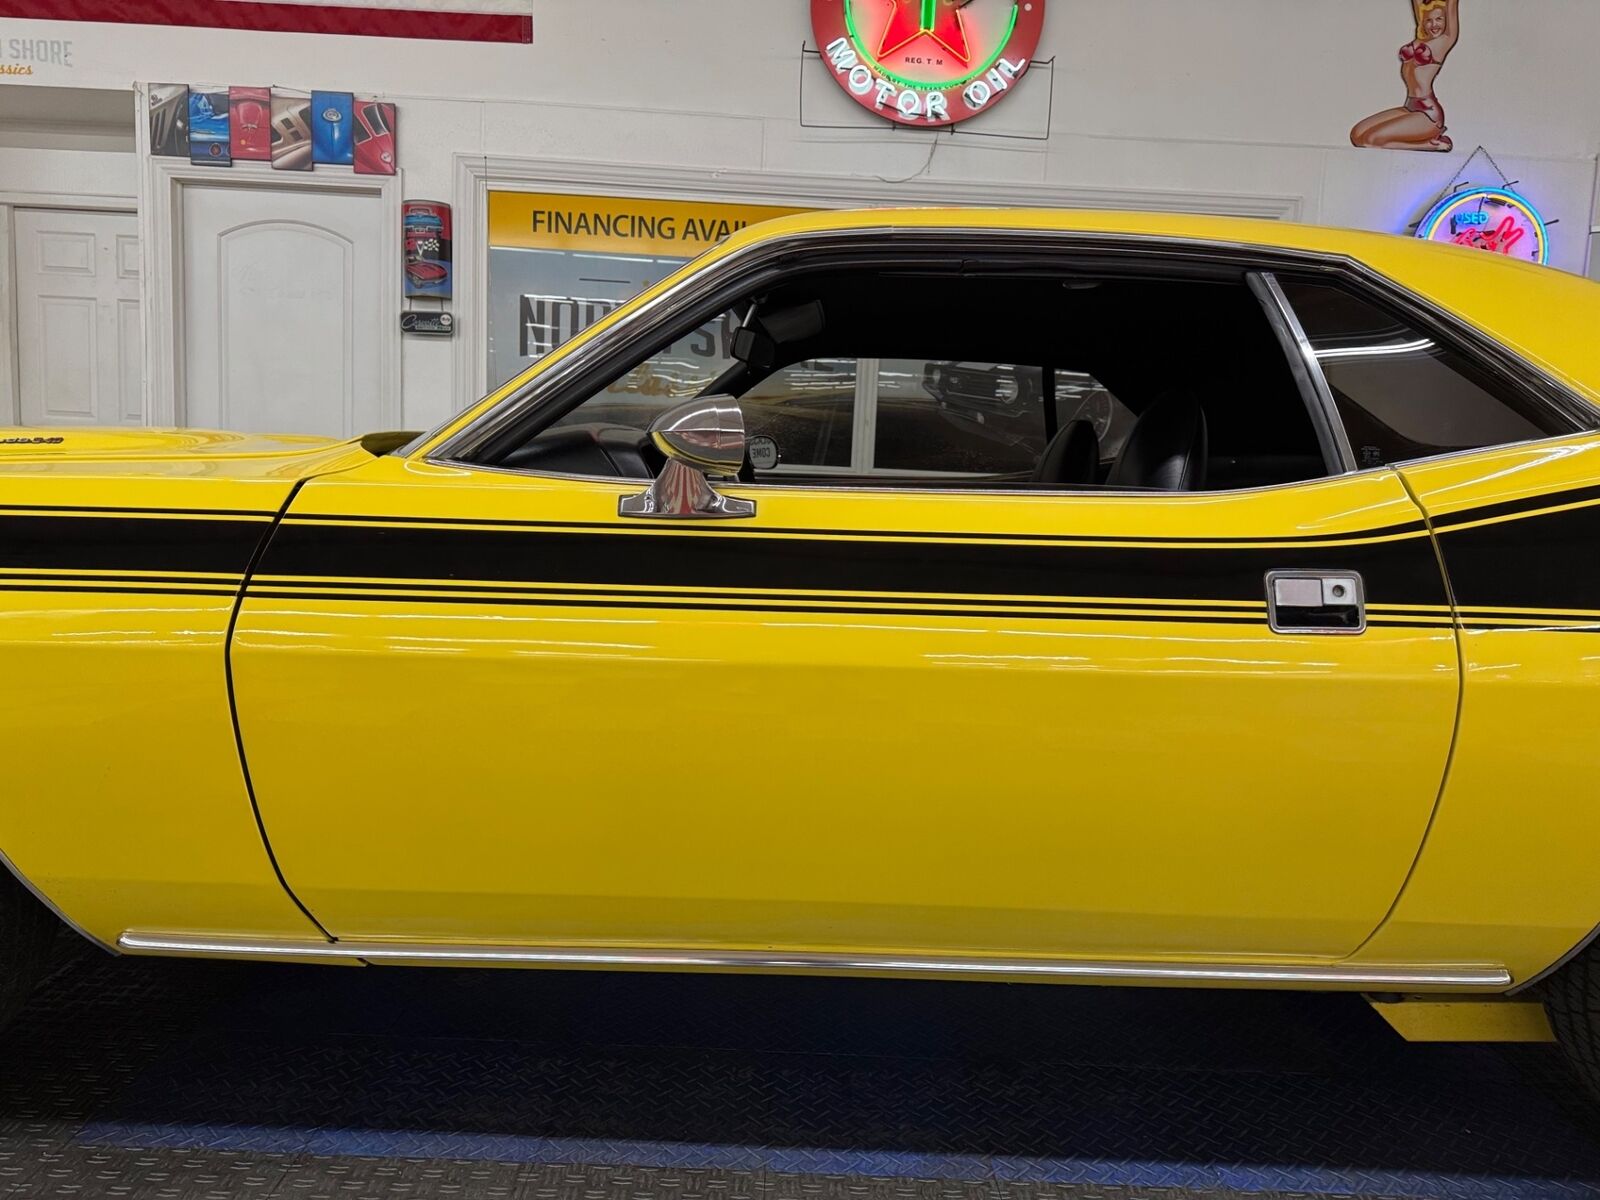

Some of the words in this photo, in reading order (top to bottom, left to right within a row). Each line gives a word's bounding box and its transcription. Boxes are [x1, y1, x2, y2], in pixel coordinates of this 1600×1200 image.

[9, 38, 73, 68] SHORE
[826, 37, 951, 121] MOTOR
[962, 57, 1026, 111] OIL
[532, 210, 675, 240] FINANCING
[1454, 211, 1489, 225] USED
